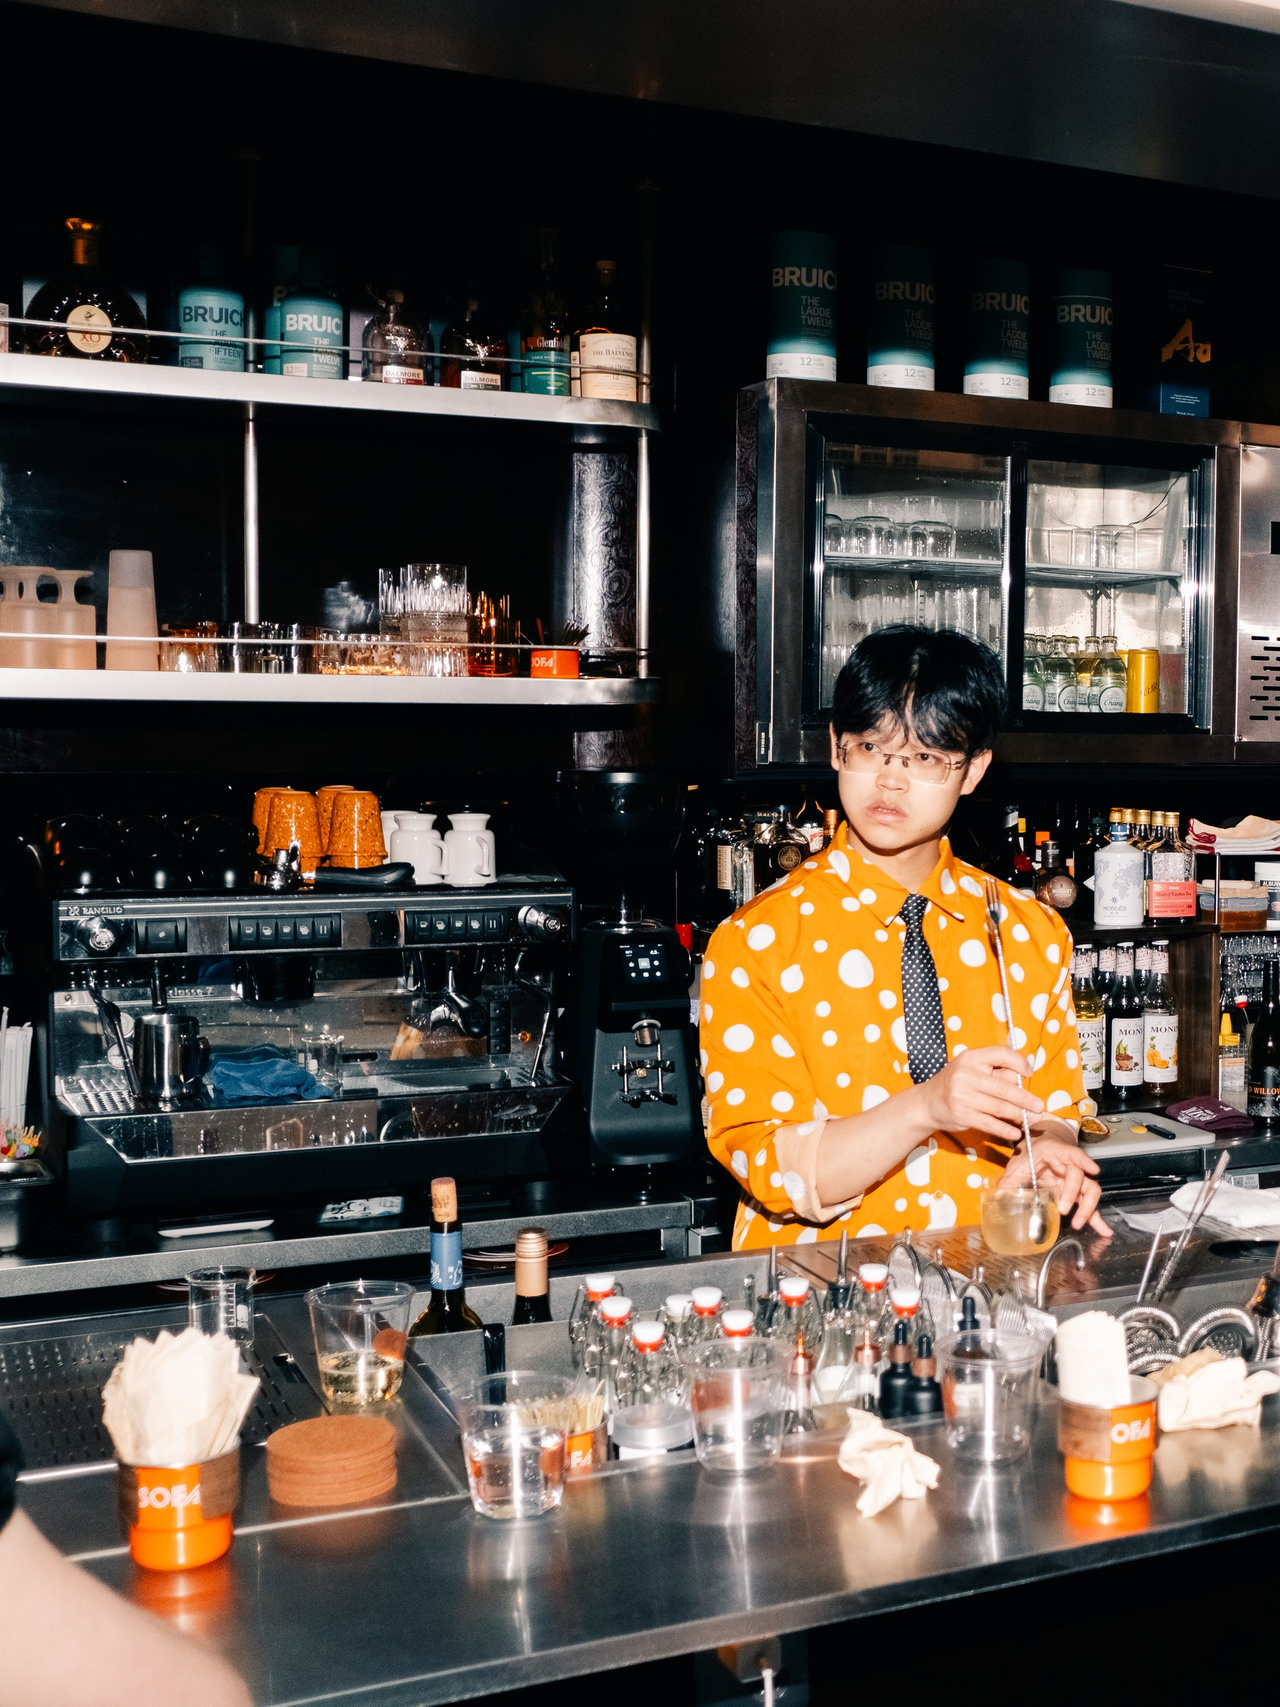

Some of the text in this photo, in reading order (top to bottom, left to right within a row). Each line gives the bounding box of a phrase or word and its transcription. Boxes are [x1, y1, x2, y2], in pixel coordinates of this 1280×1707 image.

[800, 295, 820, 307] THE
[800, 306, 831, 318] LADDIE
[800, 316, 834, 329] TWELVE
[1085, 331, 1103, 341] THE
[800, 356, 812, 366] 12
[286, 366, 294, 374] 12
[385, 370, 421, 378] DALMORE
[904, 368, 916, 377] 12
[464, 375, 499, 384] DALMORE
[1000, 377, 1011, 386] 12
[1085, 387, 1097, 396] 12
[1104, 700, 1123, 708] Chang
[82, 906, 123, 915] RANCILIO
[1110, 1417, 1151, 1445] OFA
[138, 1483, 201, 1509] SOFA
